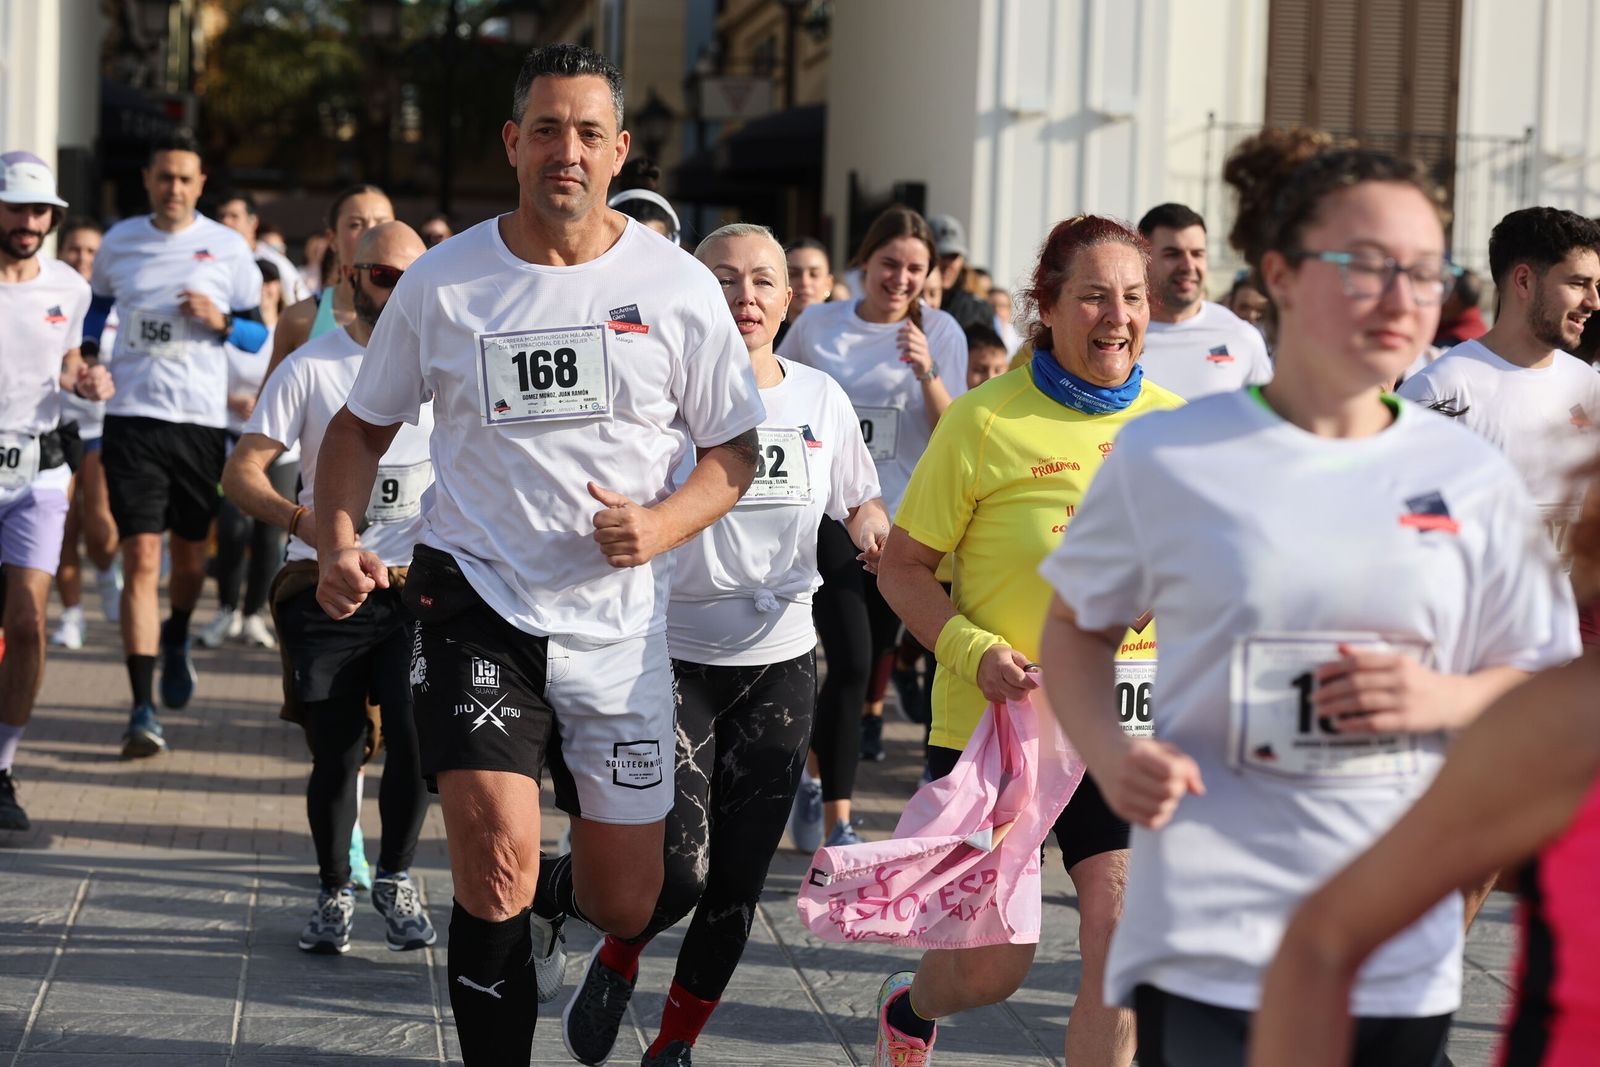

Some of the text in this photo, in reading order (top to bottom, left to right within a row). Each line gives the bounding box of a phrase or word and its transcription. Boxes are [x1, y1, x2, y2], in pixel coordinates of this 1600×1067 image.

[141, 320, 171, 342] 156
[511, 347, 578, 392] 168
[1030, 462, 1080, 478] PROLONGO
[475, 659, 495, 677] 15
[475, 676, 496, 685] arte
[475, 687, 499, 695] SUAVE
[453, 704, 521, 718] JIU JITSU
